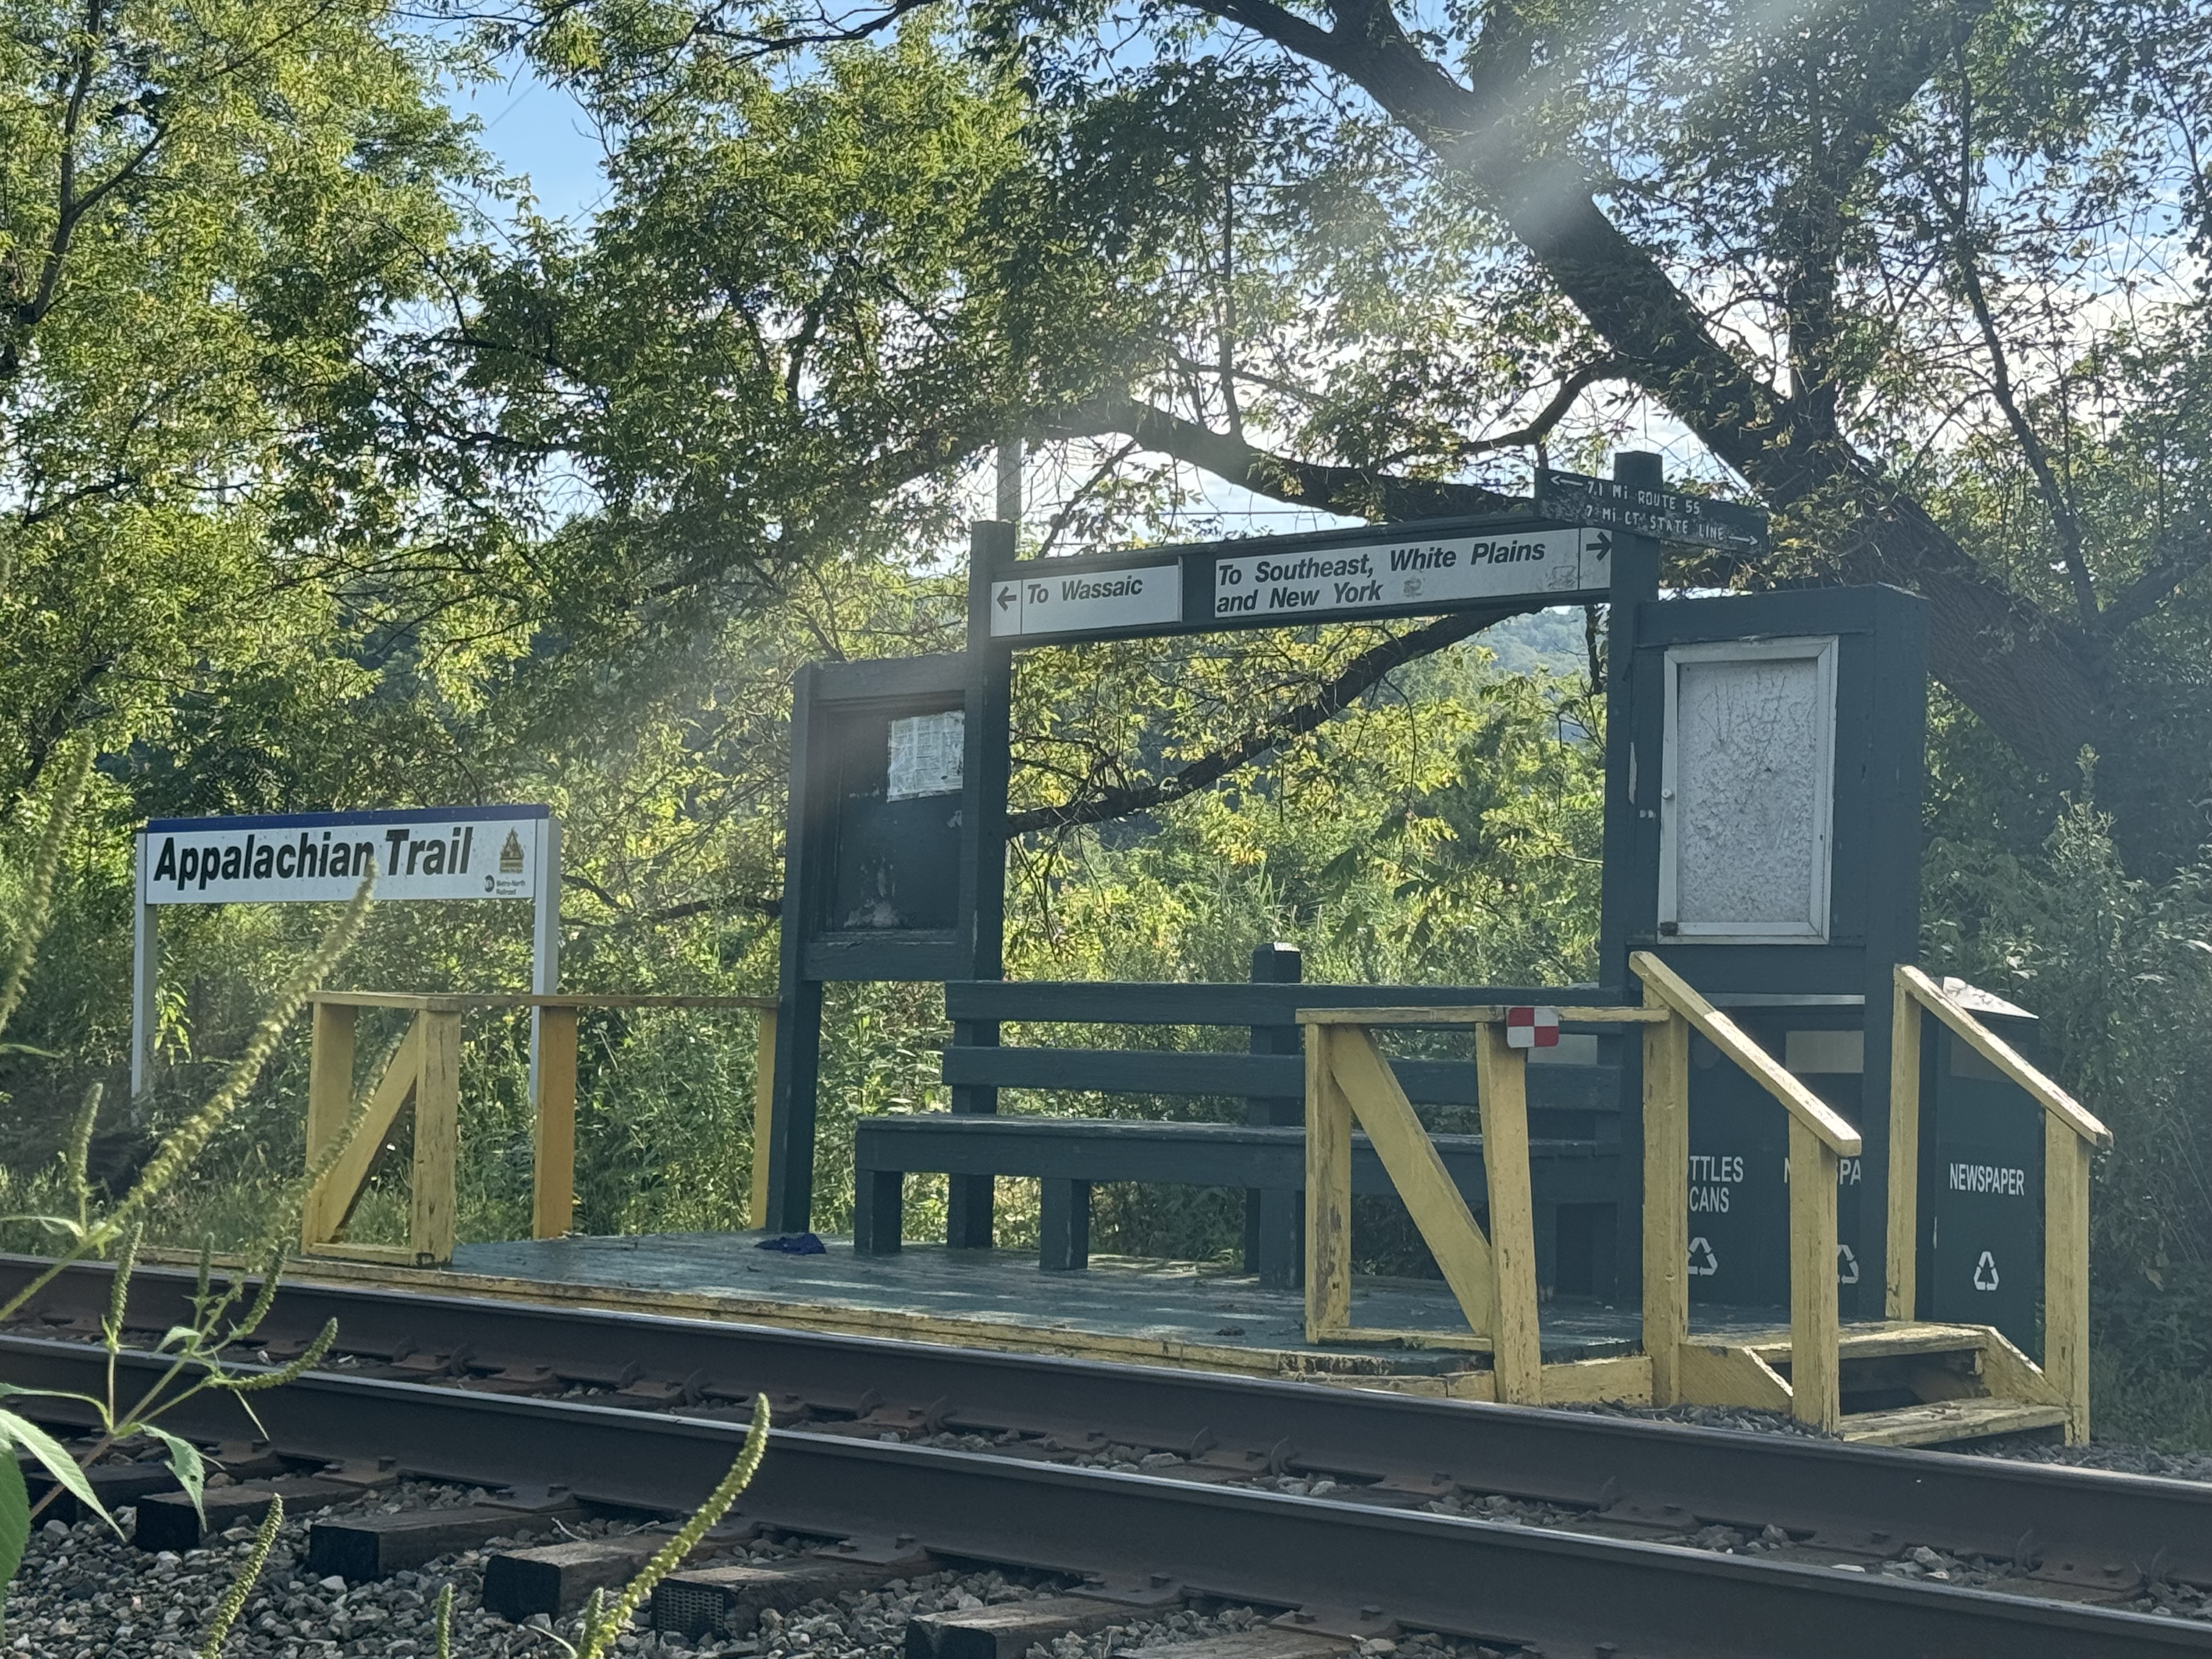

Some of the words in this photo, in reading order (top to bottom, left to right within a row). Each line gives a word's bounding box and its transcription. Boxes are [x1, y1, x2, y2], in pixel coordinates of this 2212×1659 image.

[1638, 490, 1677, 510] ROUTE
[1685, 499, 1700, 515] 55
[1650, 515, 1689, 534] STATE
[1699, 524, 1724, 541] LINE
[1218, 563, 1242, 586] To
[1256, 554, 1374, 582] Southeast,
[1390, 547, 1457, 572] White
[1471, 539, 1546, 565] Plains
[1027, 583, 1049, 605] To
[1062, 575, 1143, 601] Wassaic
[1216, 589, 1258, 613] and
[1270, 586, 1319, 608] New
[1334, 579, 1383, 604] York
[154, 832, 375, 890] Appalachian
[386, 827, 473, 877] Trail
[1690, 1156, 1744, 1183] TTLES
[1950, 1163, 2025, 1196] NEWSPAPER
[1689, 1187, 1729, 1213] CANS
